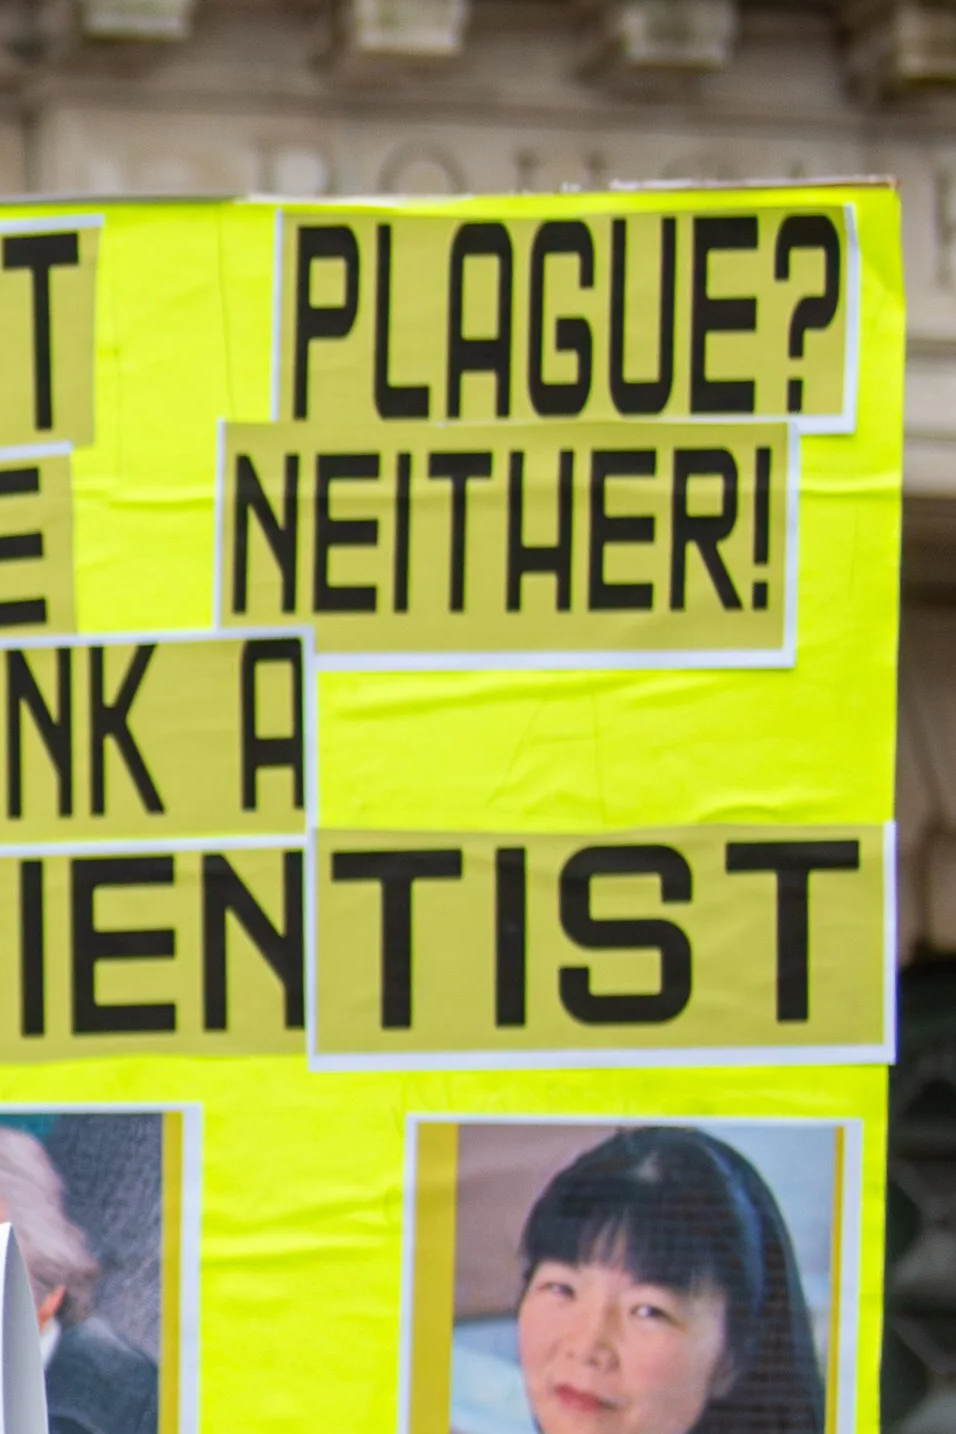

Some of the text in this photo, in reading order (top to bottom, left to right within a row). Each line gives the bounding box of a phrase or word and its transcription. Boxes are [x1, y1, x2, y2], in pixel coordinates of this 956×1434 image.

[293, 214, 841, 421] PLAGUE?
[232, 446, 772, 615] NEITHER!
[240, 637, 305, 812] A
